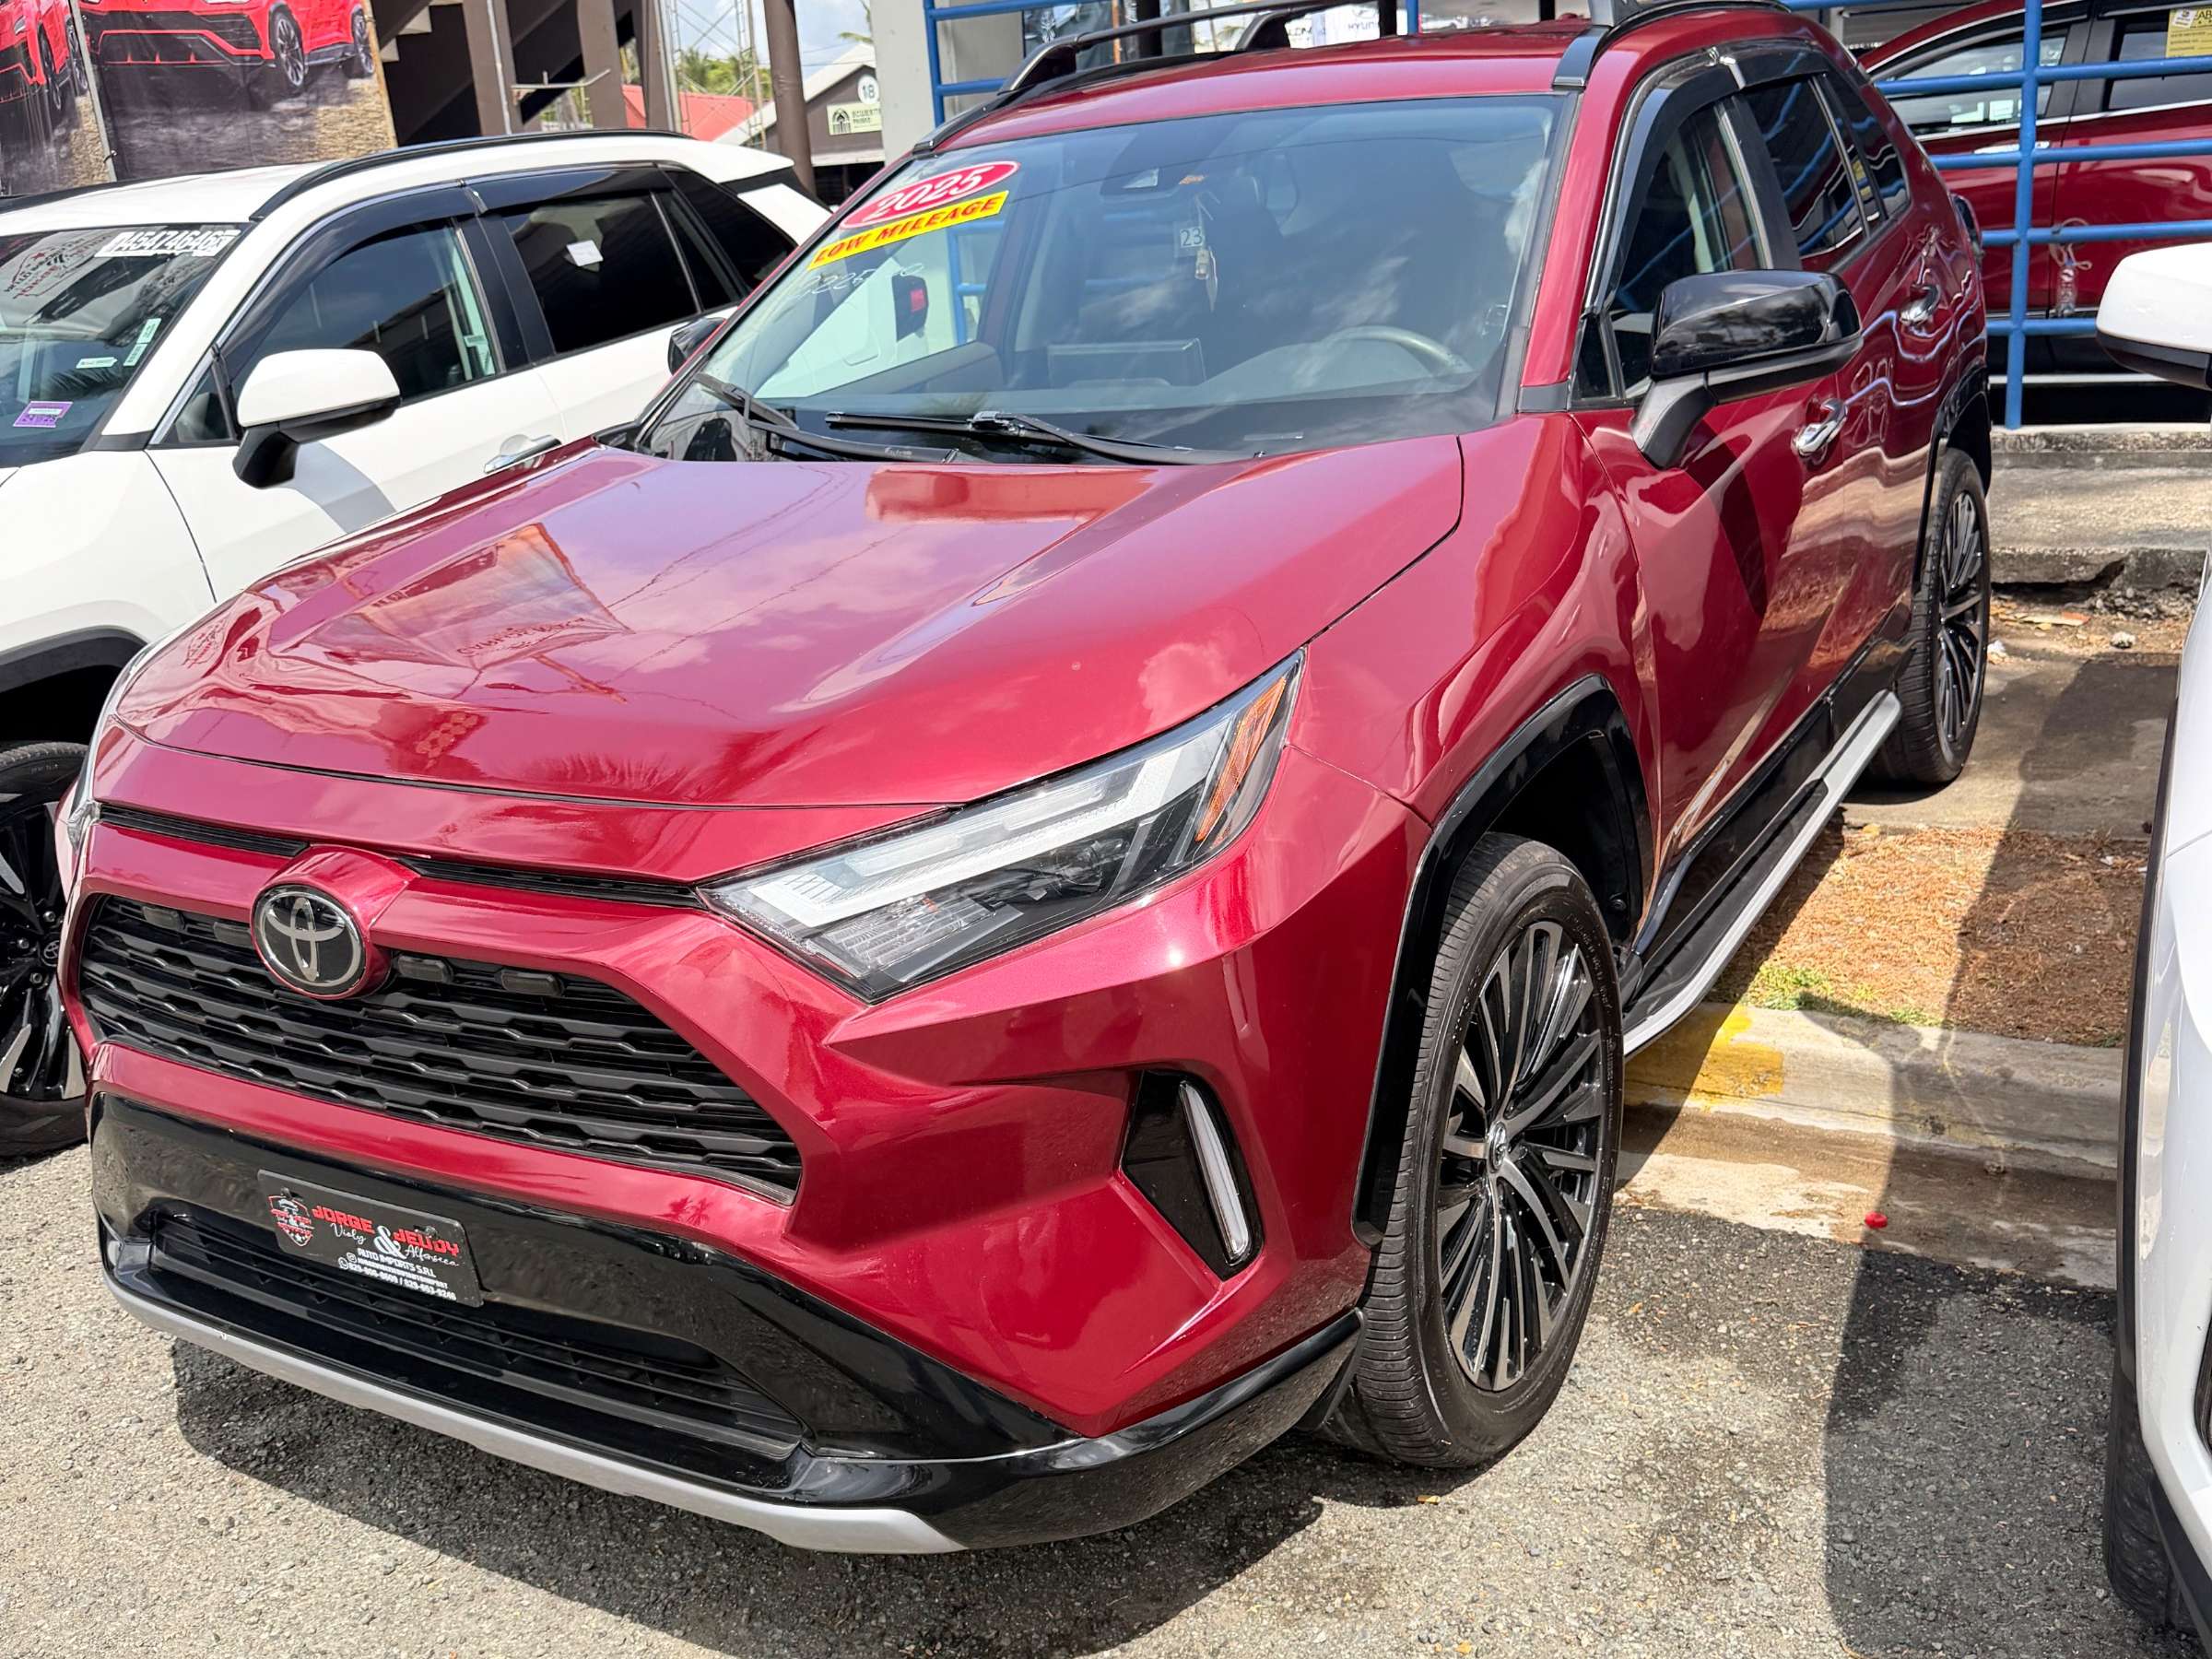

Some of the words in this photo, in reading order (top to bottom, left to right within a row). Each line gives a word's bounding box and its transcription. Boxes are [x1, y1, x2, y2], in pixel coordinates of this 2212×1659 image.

[863, 85, 875, 99] 18
[862, 165, 994, 222] 2025
[814, 233, 871, 264] LOW
[875, 195, 1004, 242] MILEAGE
[1181, 229, 1203, 246] 23
[312, 1205, 375, 1236] JORGE
[357, 1248, 379, 1261] AUTO
[379, 1255, 416, 1272] IMPORTS
